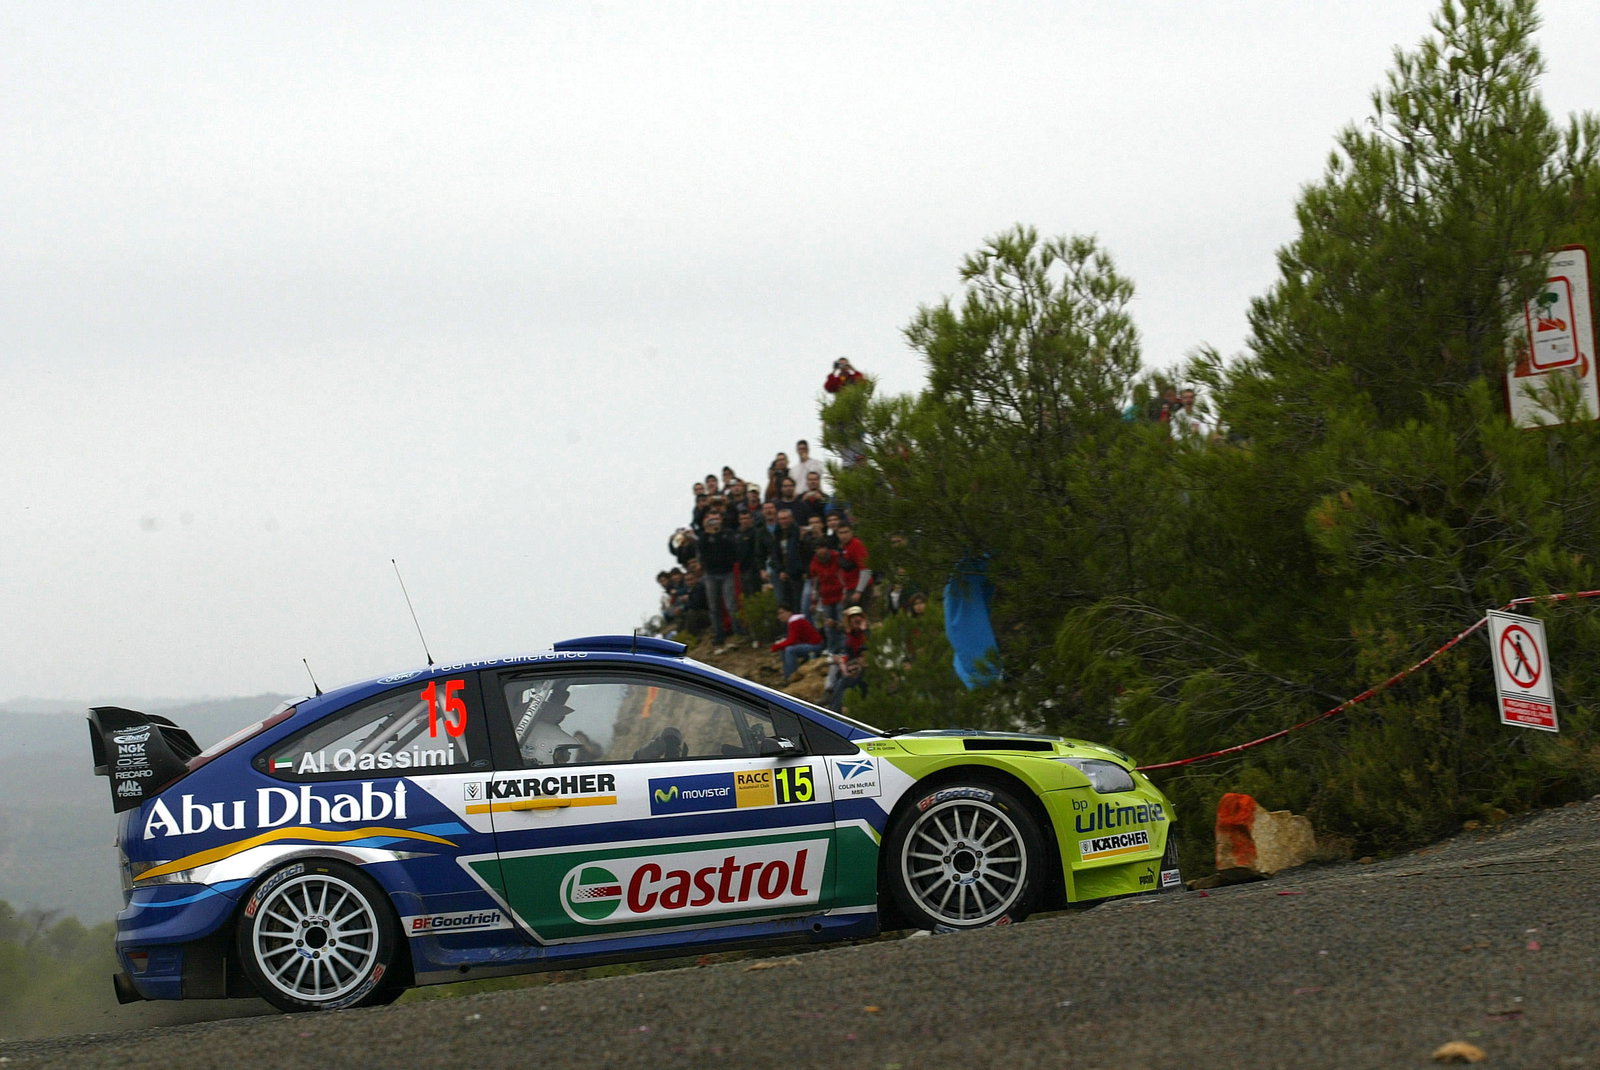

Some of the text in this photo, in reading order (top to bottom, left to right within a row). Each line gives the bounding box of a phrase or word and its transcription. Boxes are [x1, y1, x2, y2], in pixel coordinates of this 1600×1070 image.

[420, 679, 468, 738] 15
[118, 743, 146, 754] NGK
[297, 743, 454, 775] Al Qassimi
[115, 769, 153, 779] RECARO
[117, 780, 142, 792] MAC
[485, 773, 616, 799] KÄRCHER
[738, 772, 769, 784] RACC
[776, 767, 813, 802] 15
[682, 787, 731, 799] movistar
[919, 788, 992, 812] BFGoodrich
[143, 780, 408, 840] Abu Dhabi
[1072, 799, 1088, 812] bp
[1075, 801, 1165, 833] ultimate
[1092, 831, 1148, 852] KÄRCHER
[246, 864, 303, 916] BFGoodrich
[627, 848, 808, 913] Castrol
[412, 912, 500, 929] BFGoodrich
